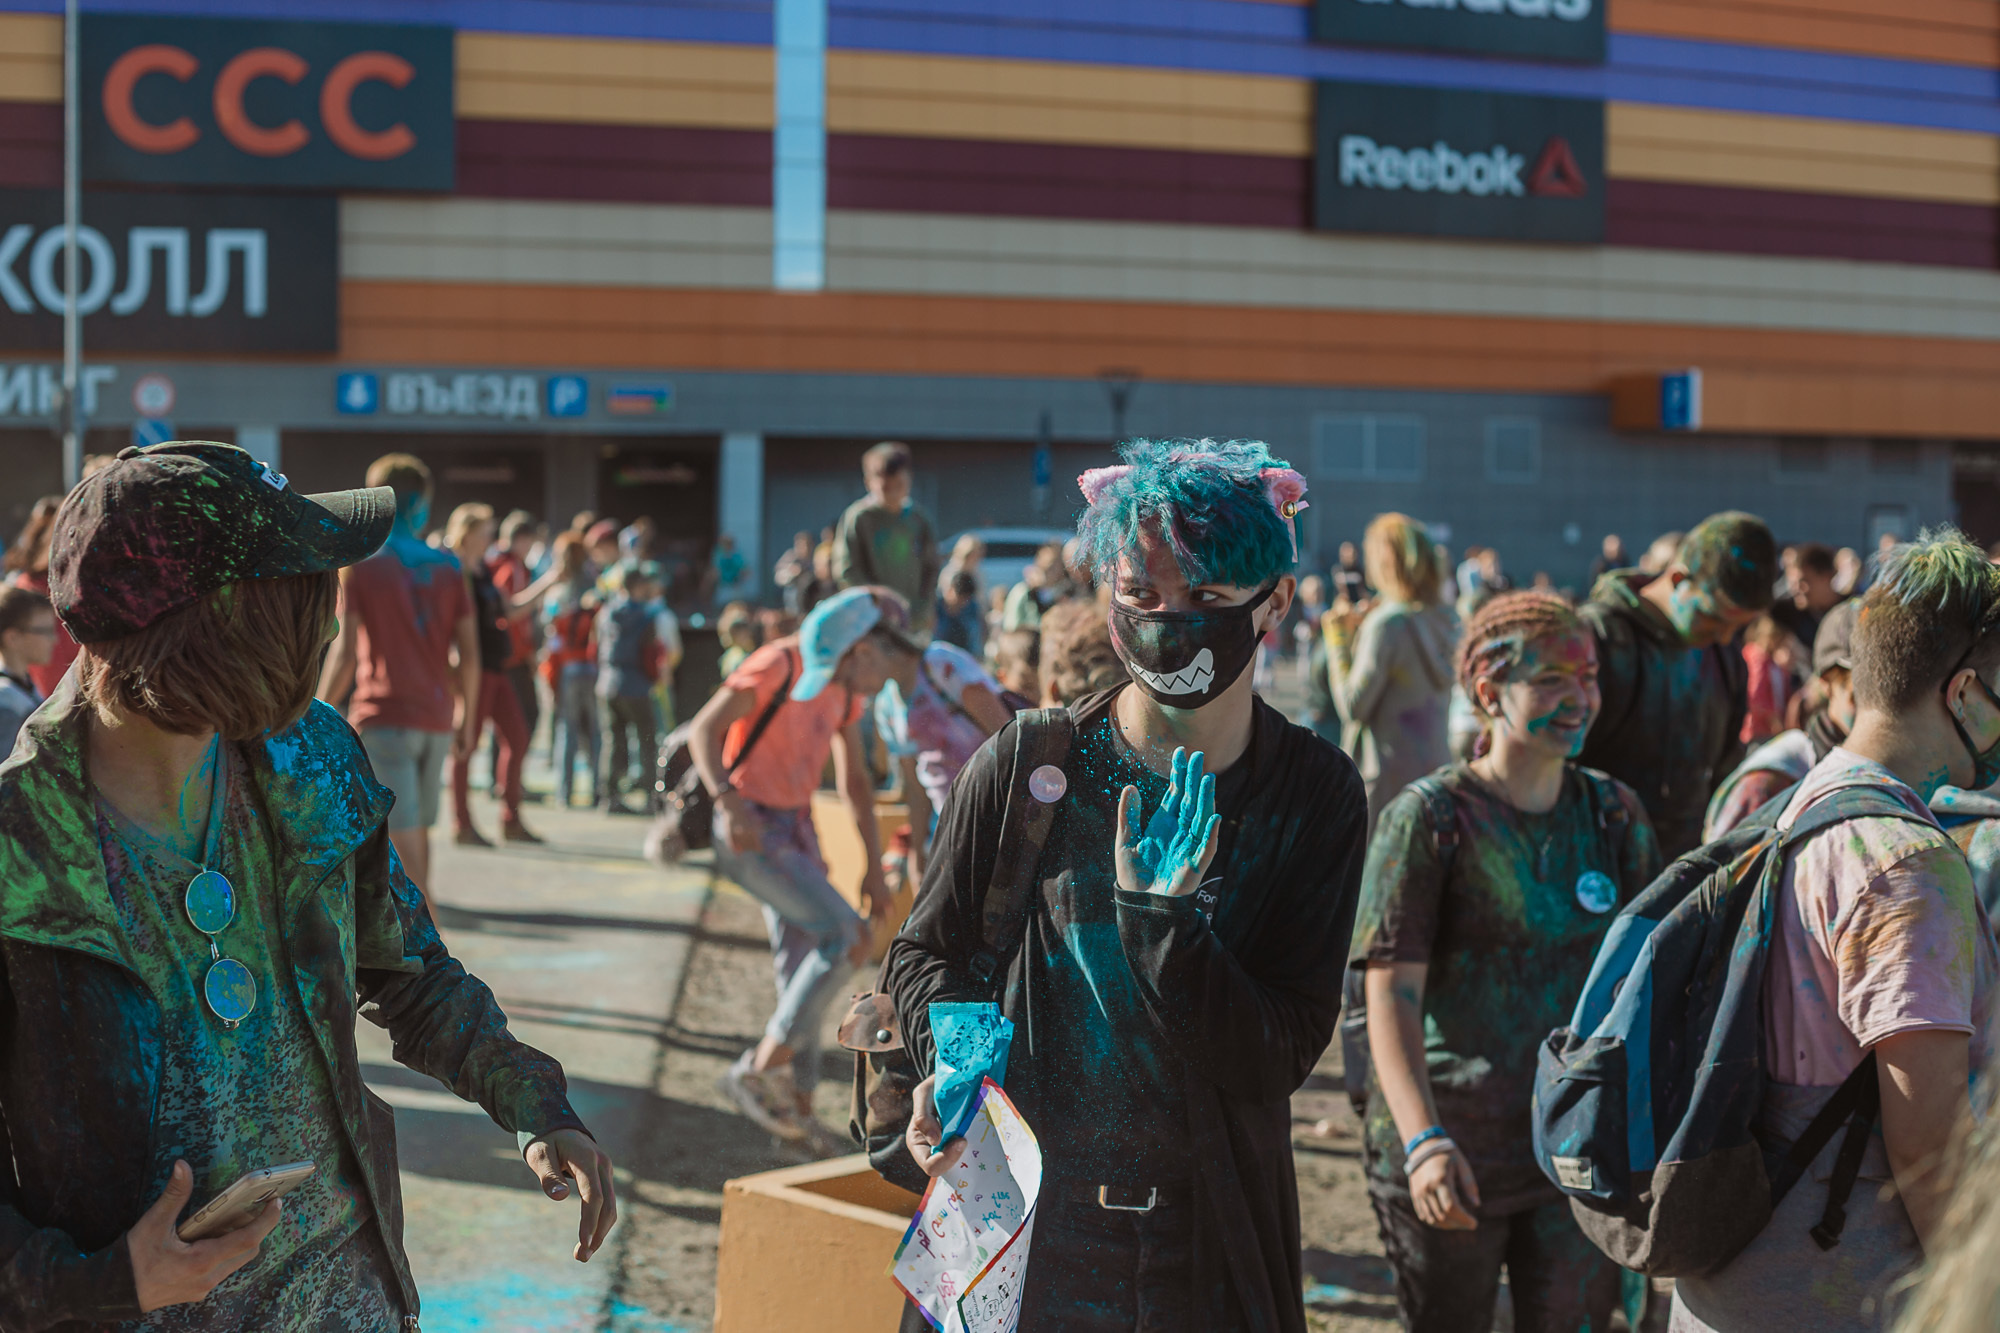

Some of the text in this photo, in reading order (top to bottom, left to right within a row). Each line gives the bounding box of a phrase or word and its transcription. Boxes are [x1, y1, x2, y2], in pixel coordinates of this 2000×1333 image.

[103, 44, 416, 160] CCC
[1338, 134, 1526, 196] Reebok
[386, 373, 540, 420] ВЪЕЗД
